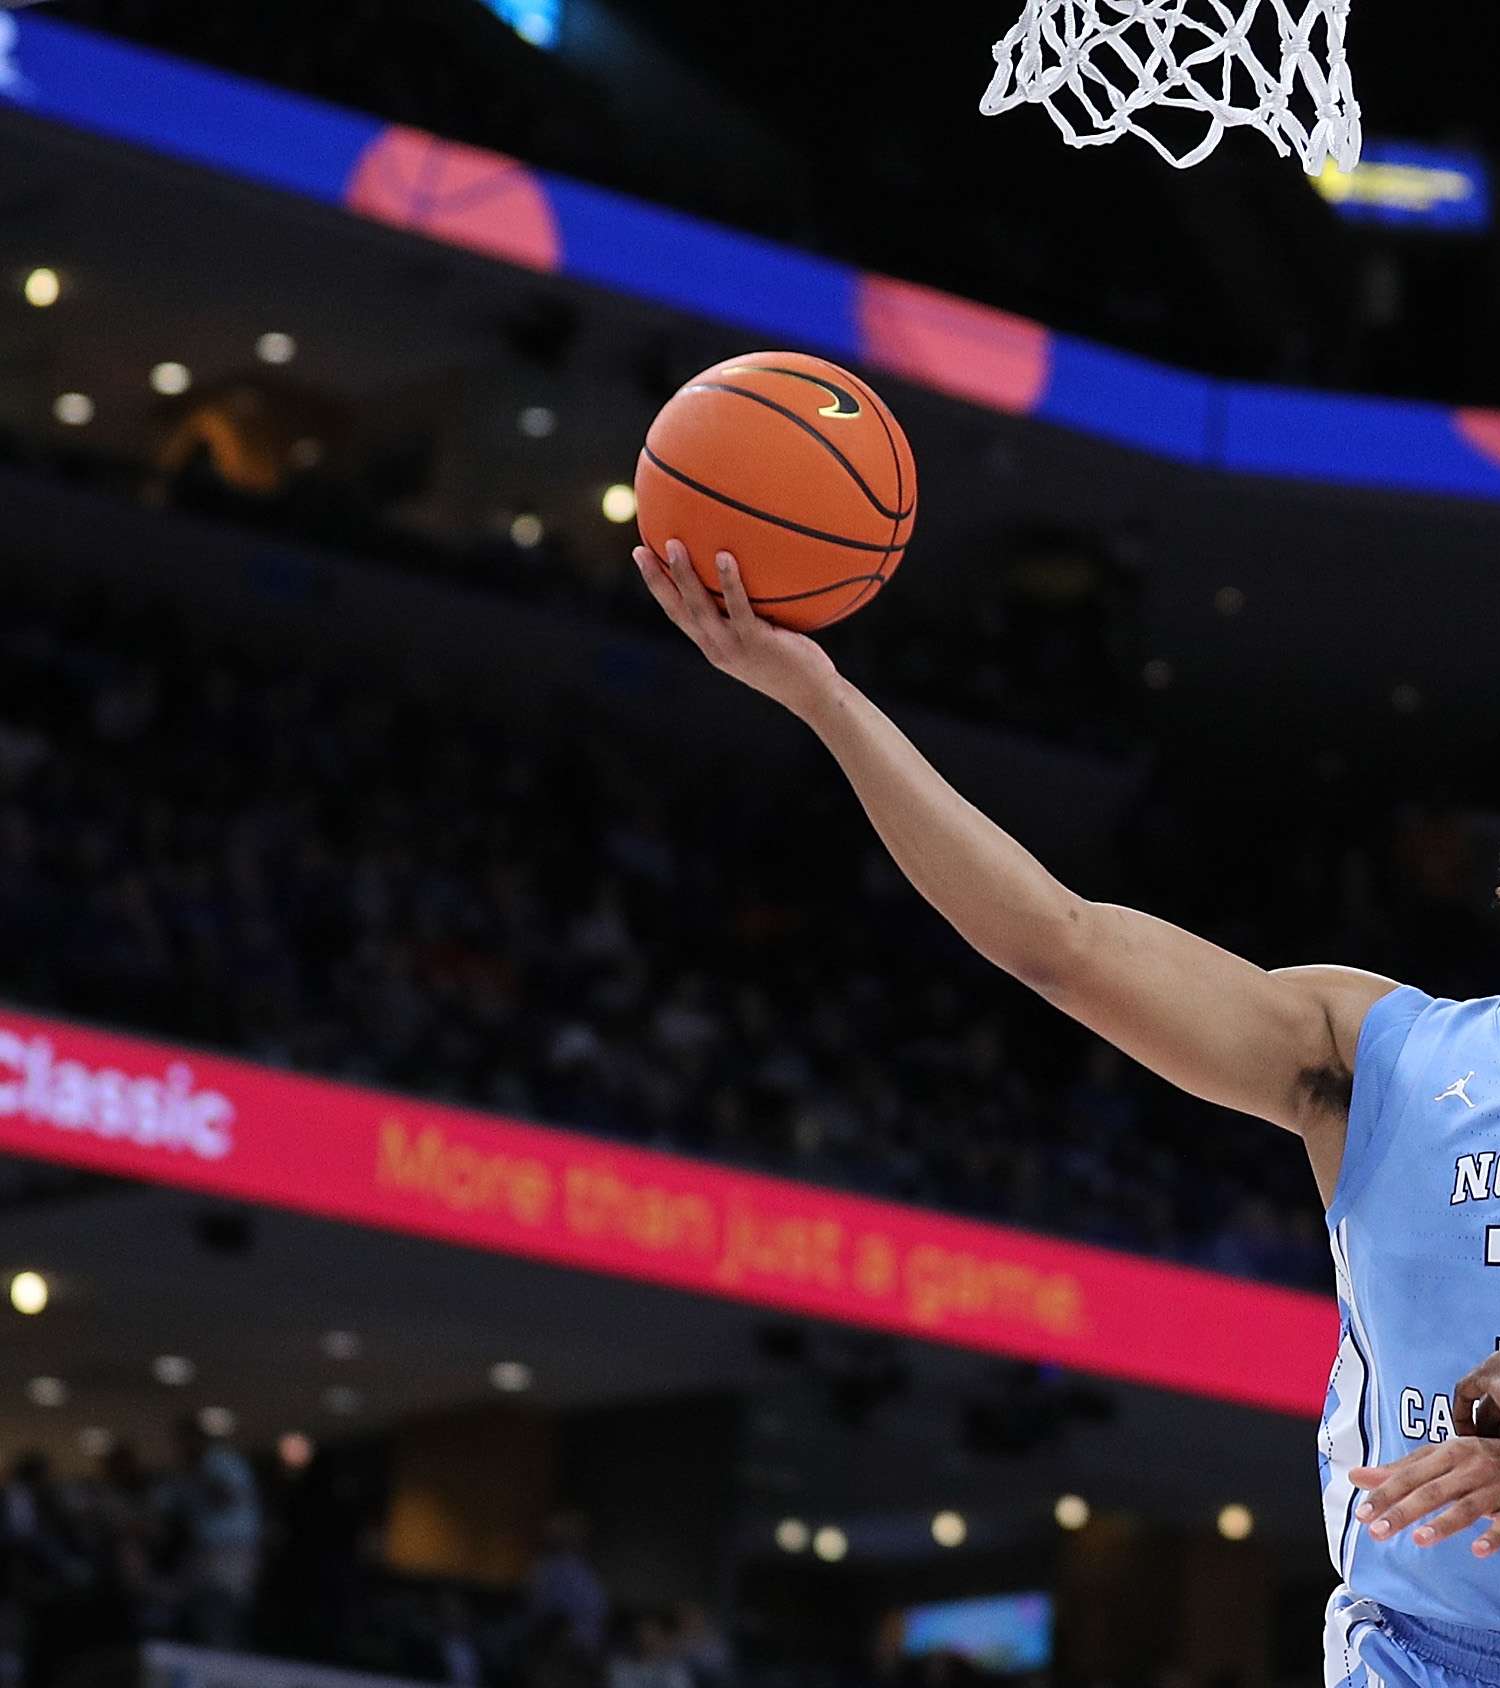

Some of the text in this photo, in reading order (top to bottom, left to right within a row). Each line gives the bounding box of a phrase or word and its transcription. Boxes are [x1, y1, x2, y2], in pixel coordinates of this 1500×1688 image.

[376, 1116, 553, 1226] More
[562, 1158, 716, 1257] than
[714, 1190, 842, 1289] just
[853, 1232, 897, 1297] a
